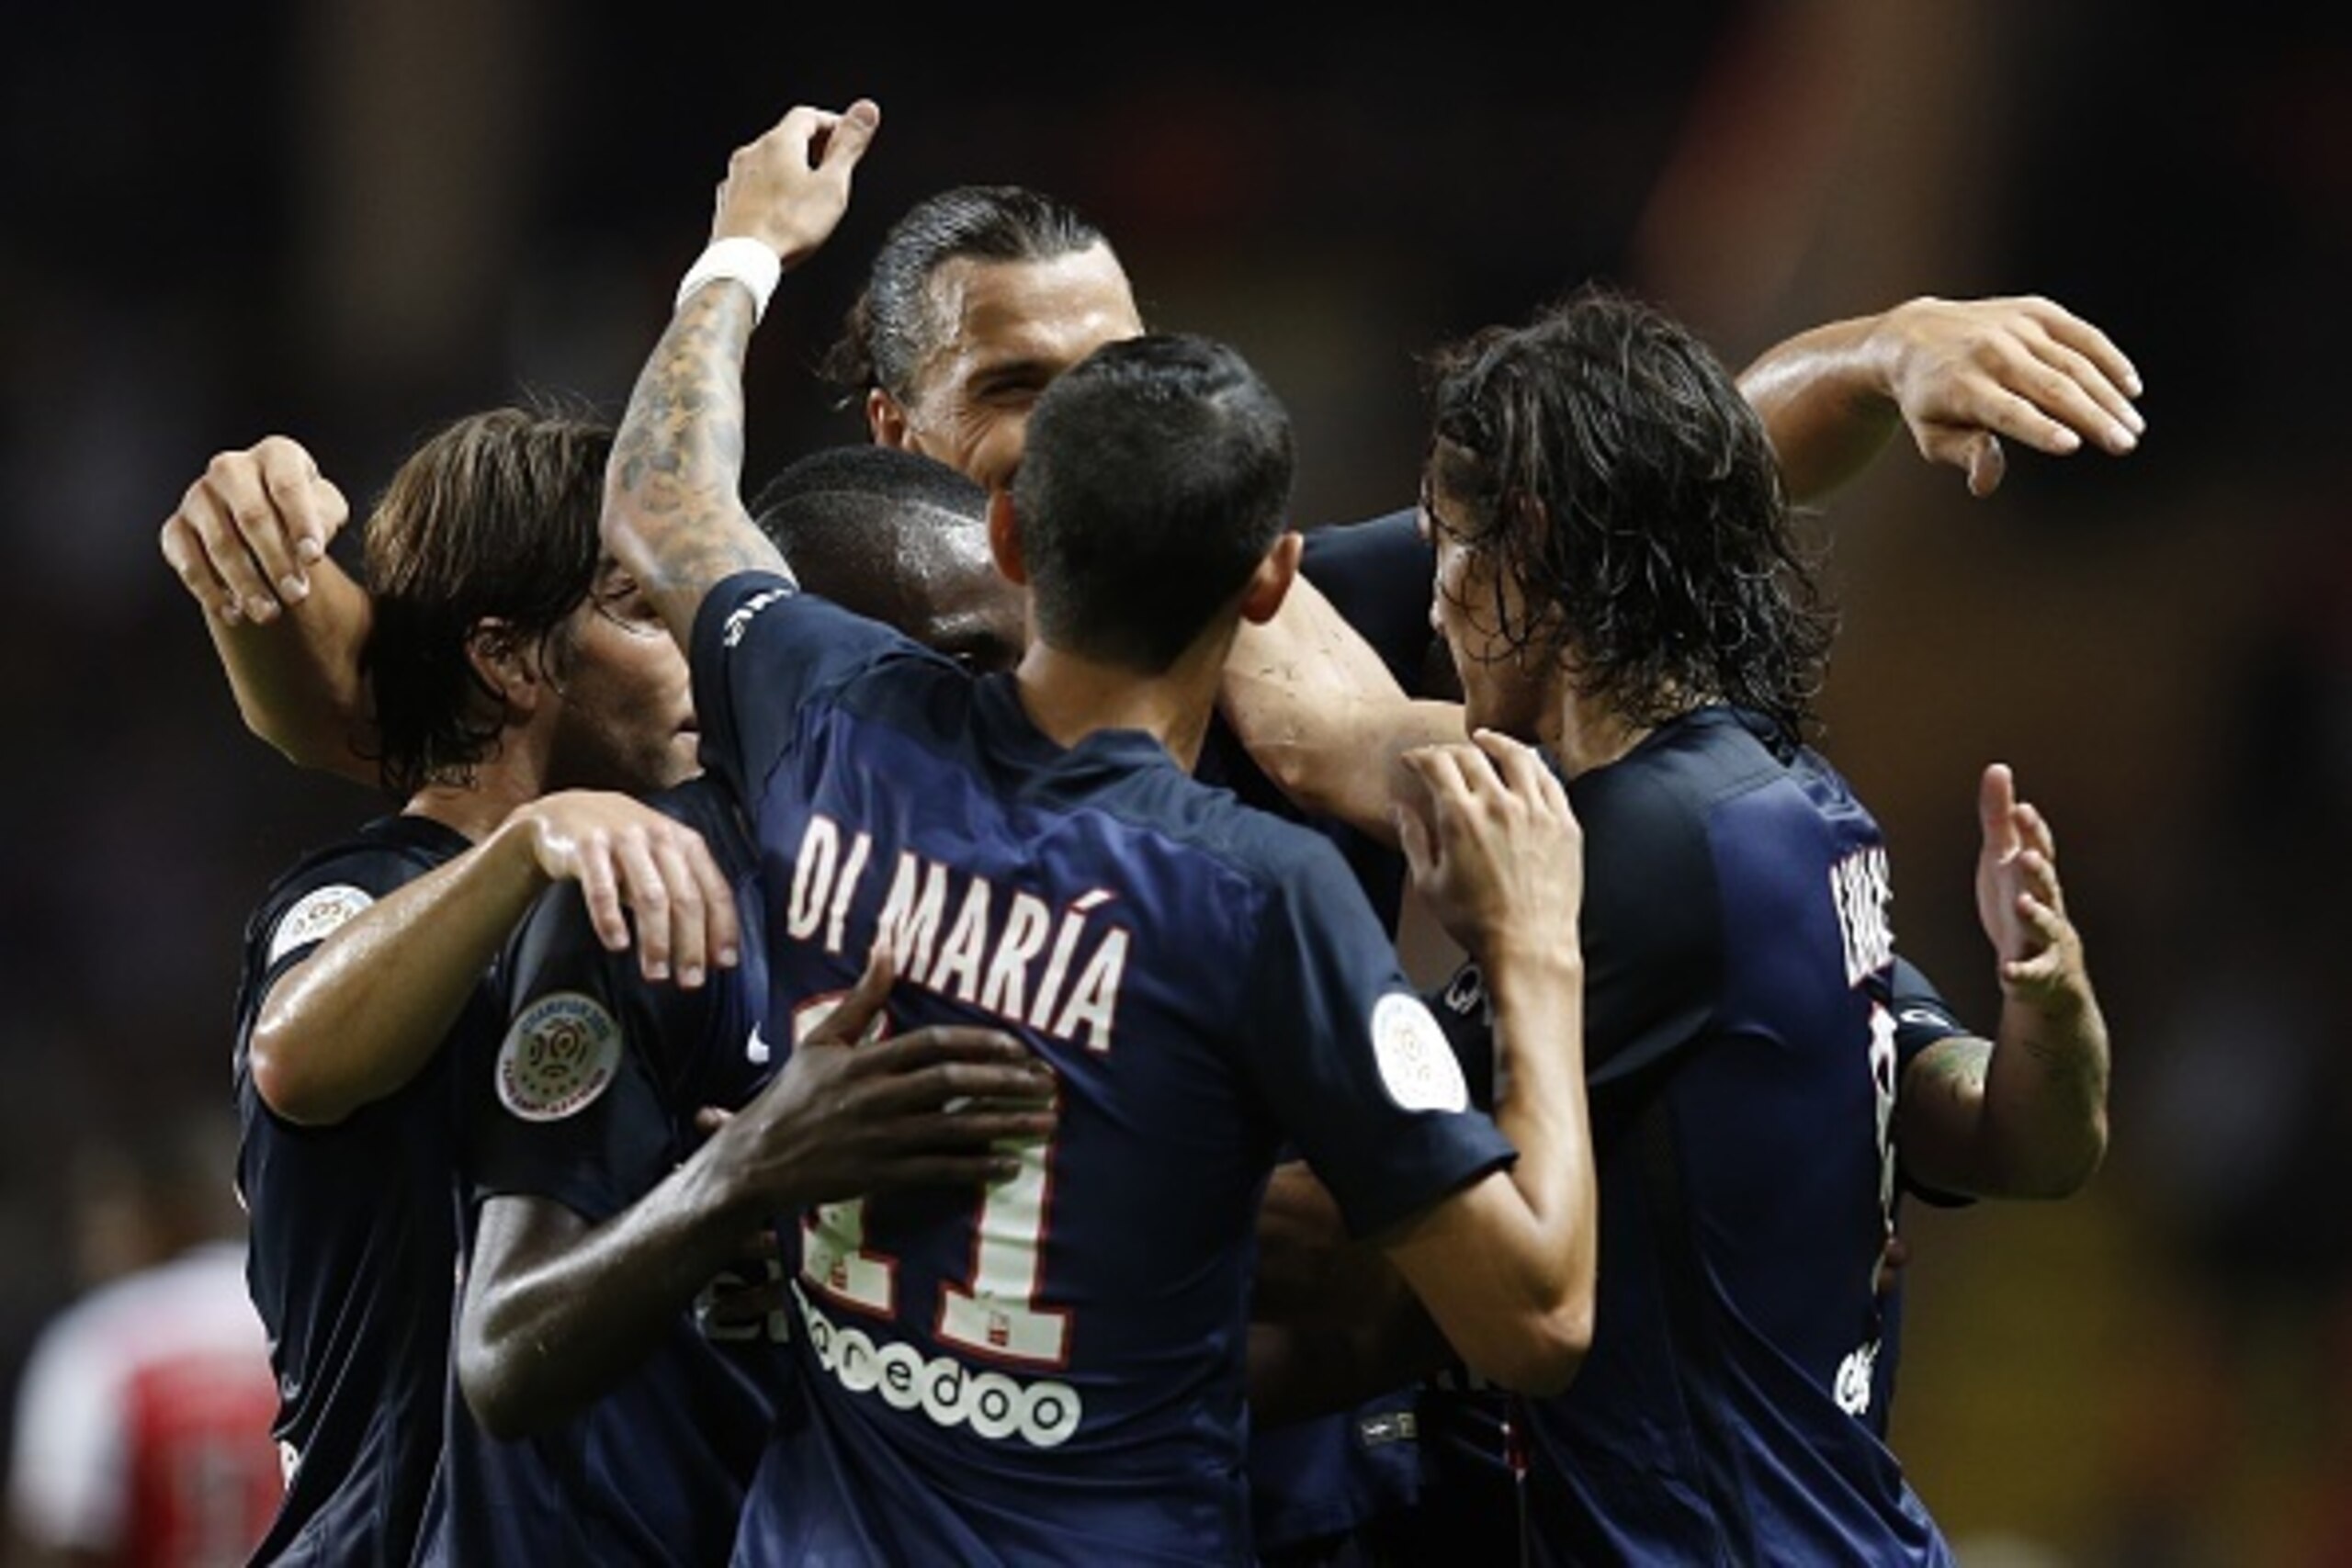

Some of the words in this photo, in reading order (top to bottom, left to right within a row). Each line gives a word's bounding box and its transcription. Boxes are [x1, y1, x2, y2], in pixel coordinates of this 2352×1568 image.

[786, 815, 872, 953] DI
[878, 849, 1131, 1053] MARÍA
[790, 1278, 1082, 1448] oredoo
